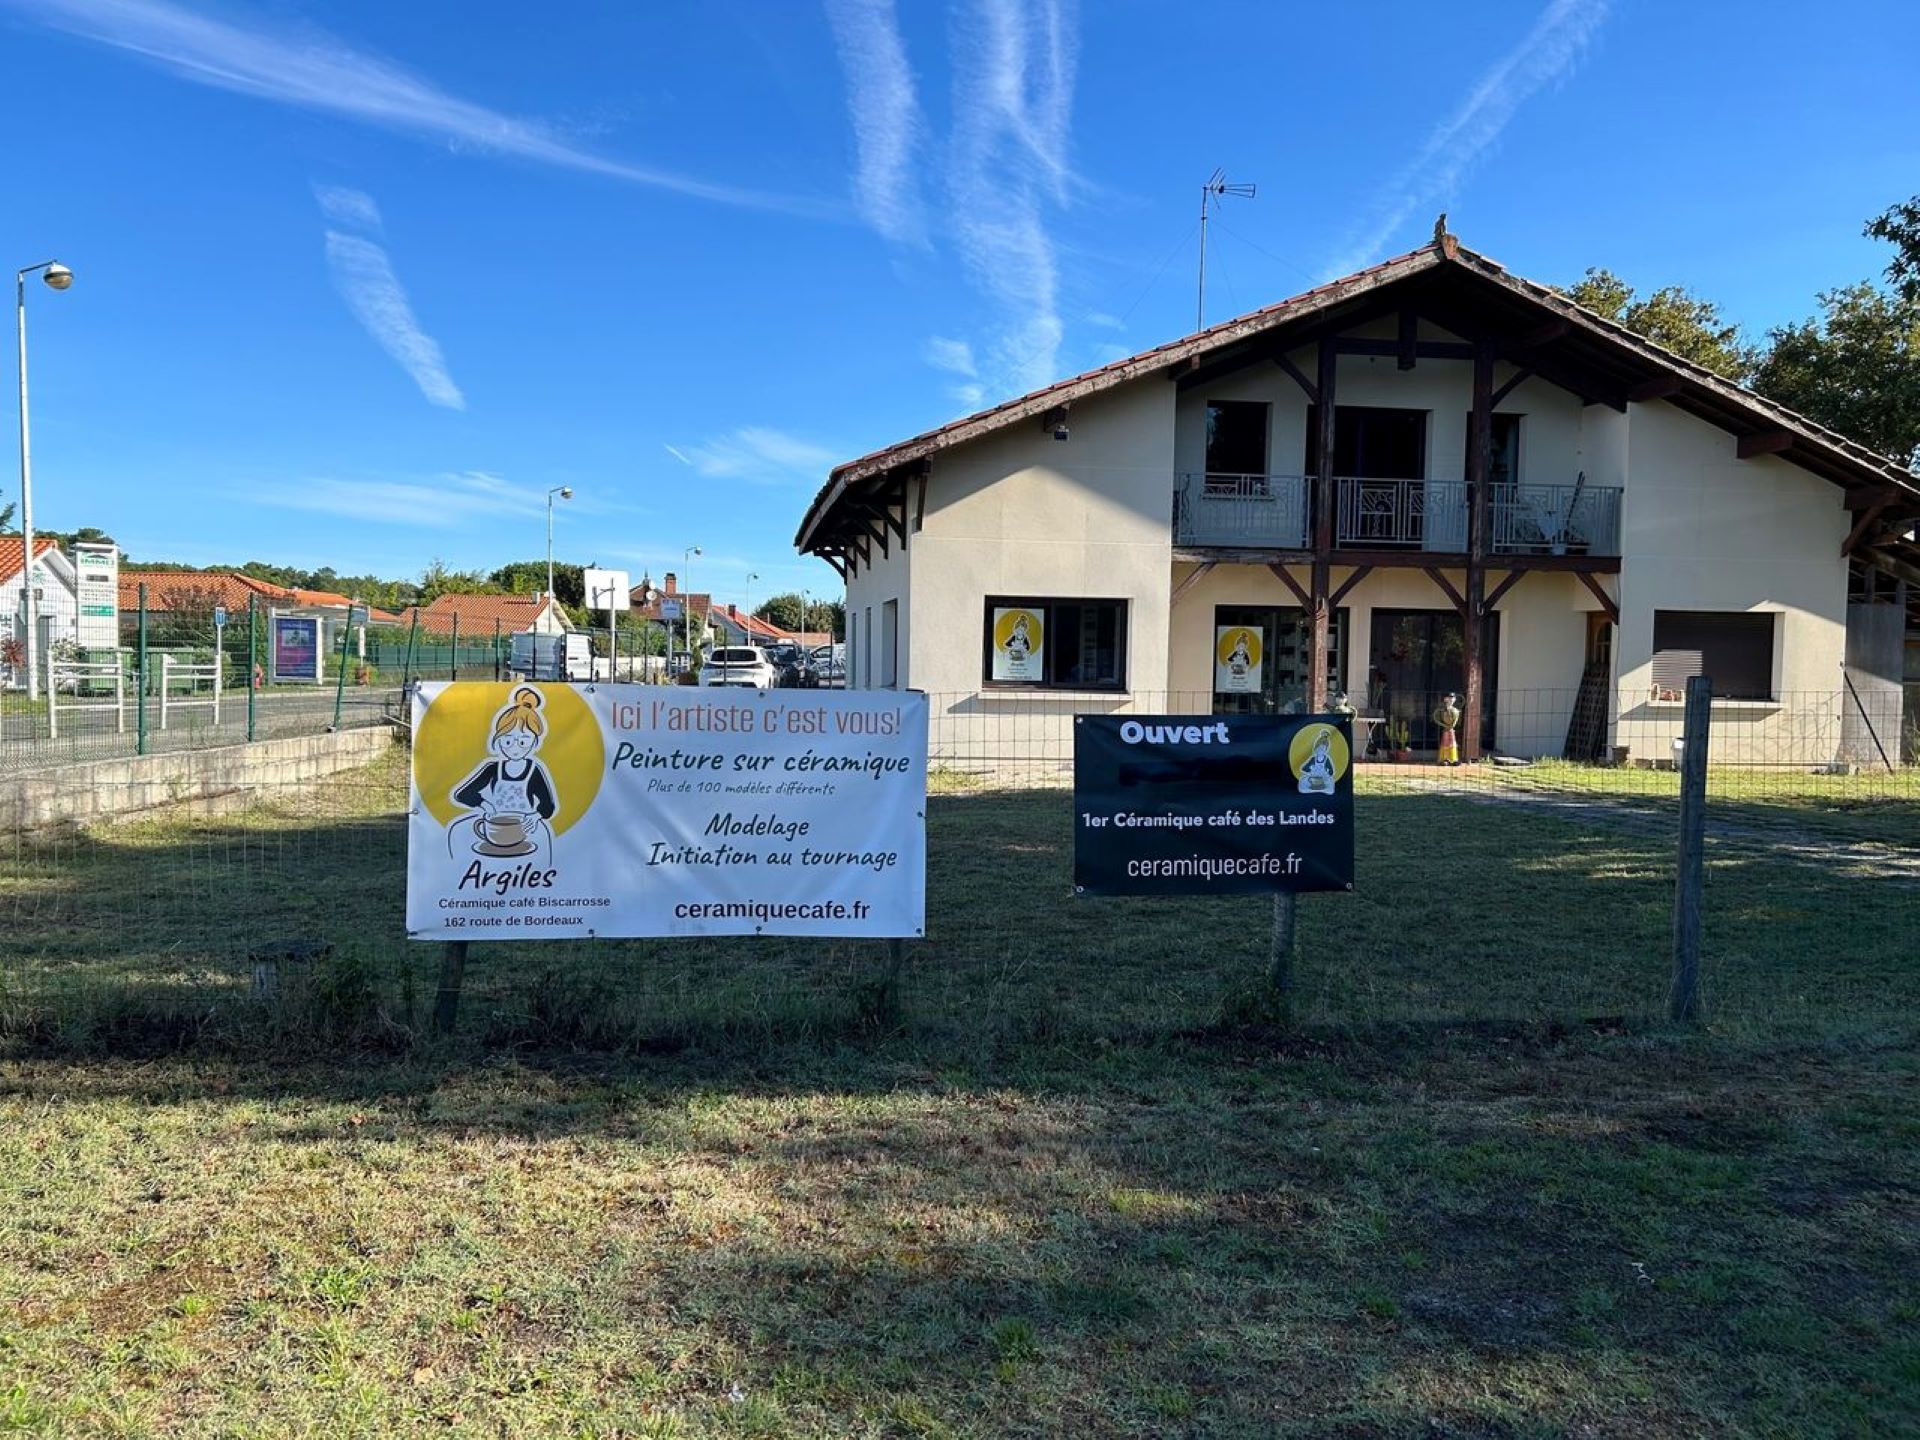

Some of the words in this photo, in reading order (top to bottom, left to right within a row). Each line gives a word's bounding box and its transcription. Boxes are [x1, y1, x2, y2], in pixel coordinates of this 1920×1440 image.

[612, 701, 641, 730] Ici
[651, 700, 754, 733] l'artiste
[763, 704, 828, 734] c'est
[835, 706, 901, 735] vous!
[1119, 720, 1230, 745] Ouvert
[612, 741, 724, 770] Peinture
[732, 753, 775, 771] sur
[783, 748, 911, 780] céramique
[647, 778, 674, 793] Plus
[677, 780, 692, 793] de
[696, 781, 722, 793] 100
[725, 781, 773, 794] modèles
[775, 781, 836, 796] différents
[704, 812, 810, 842] Modelage
[1082, 812, 1109, 827] 1er
[1113, 811, 1203, 831] Céramique
[1208, 810, 1241, 826] café
[1246, 810, 1274, 825] des
[1279, 809, 1334, 825] Landes
[646, 842, 758, 866] Initiation
[766, 850, 793, 865] au
[801, 848, 898, 872] tournage
[1127, 852, 1303, 880] ceramiquecafe.fr
[458, 859, 557, 896] Argiles
[438, 897, 505, 911] Céramique
[509, 897, 535, 908] café
[538, 897, 611, 908] Biscarrosse
[675, 900, 870, 922] ceramiquecafe.fr
[444, 917, 466, 928] 162
[470, 917, 502, 927] route
[506, 916, 521, 926] de
[524, 915, 583, 926] Bordeaux
